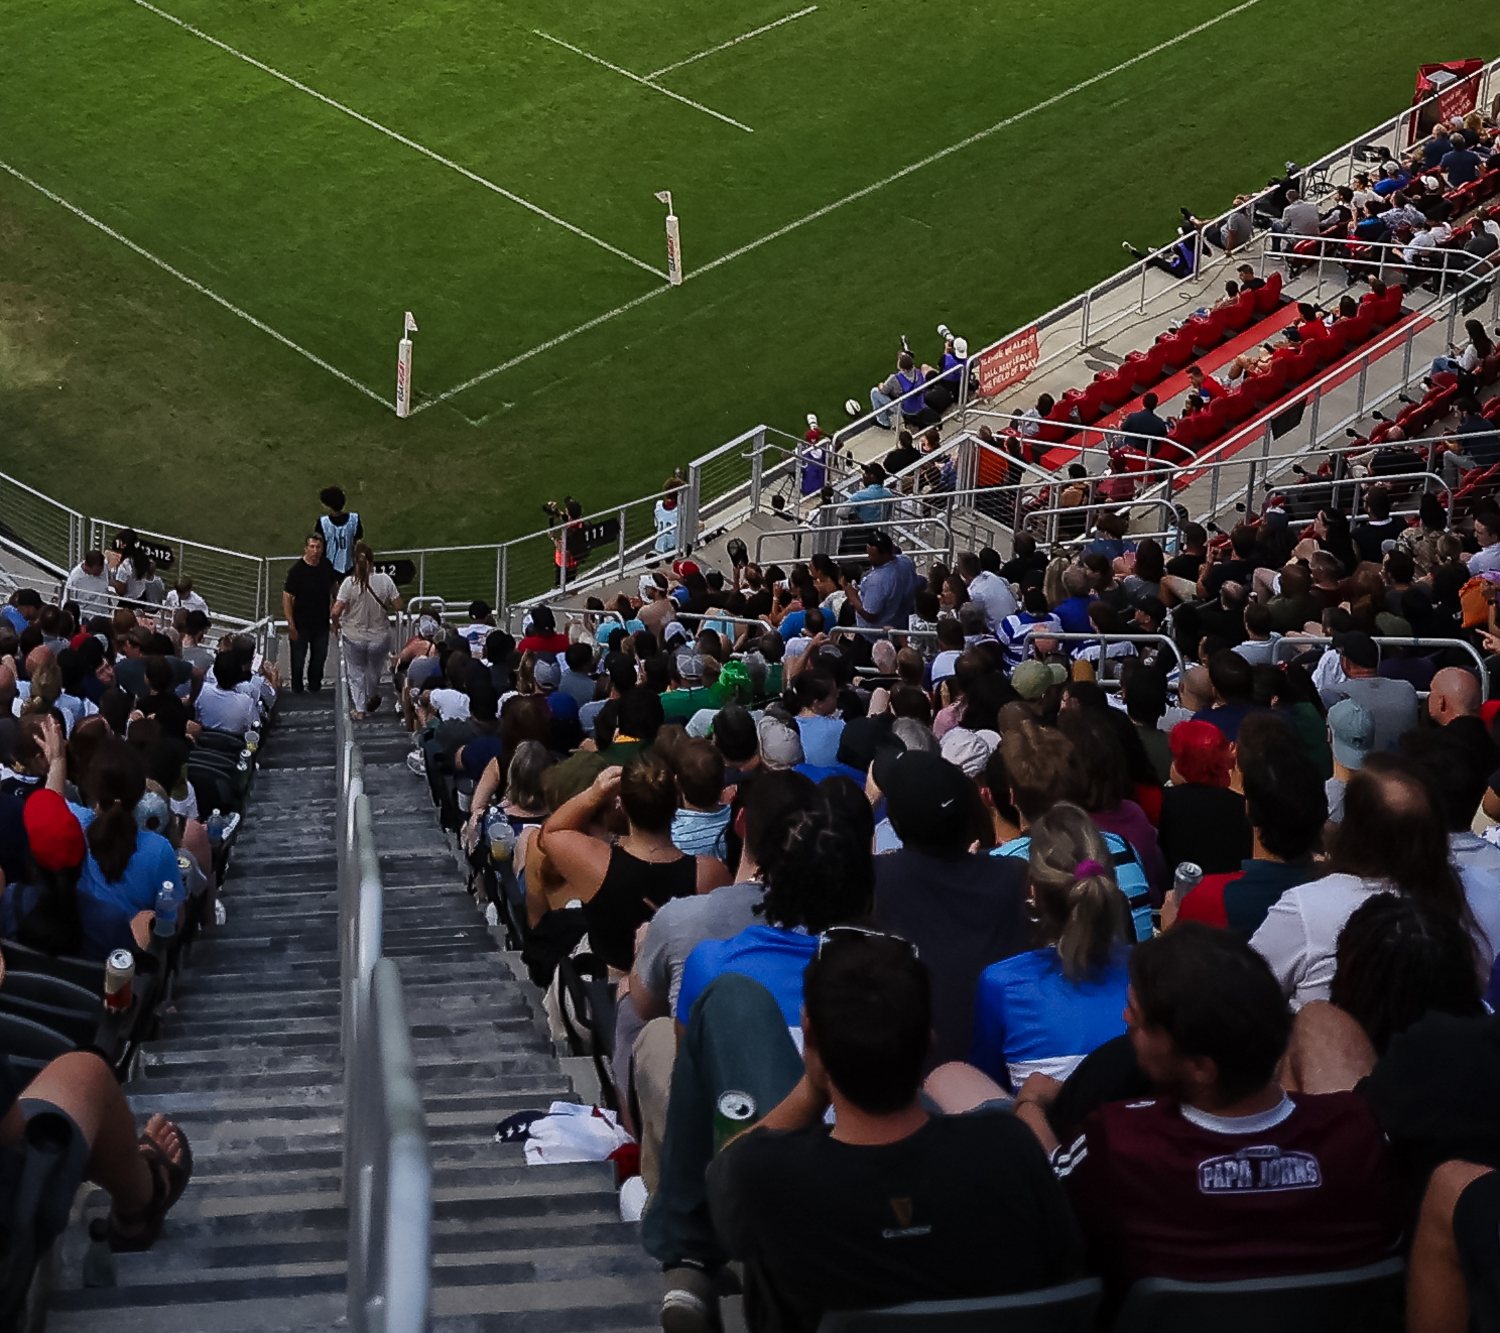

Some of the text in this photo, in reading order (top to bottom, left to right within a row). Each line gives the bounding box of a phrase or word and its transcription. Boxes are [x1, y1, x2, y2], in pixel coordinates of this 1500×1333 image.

[1019, 358, 1036, 372] PLAY
[584, 525, 604, 542] 111
[1203, 1157, 1318, 1188] PAPA JOHNS
